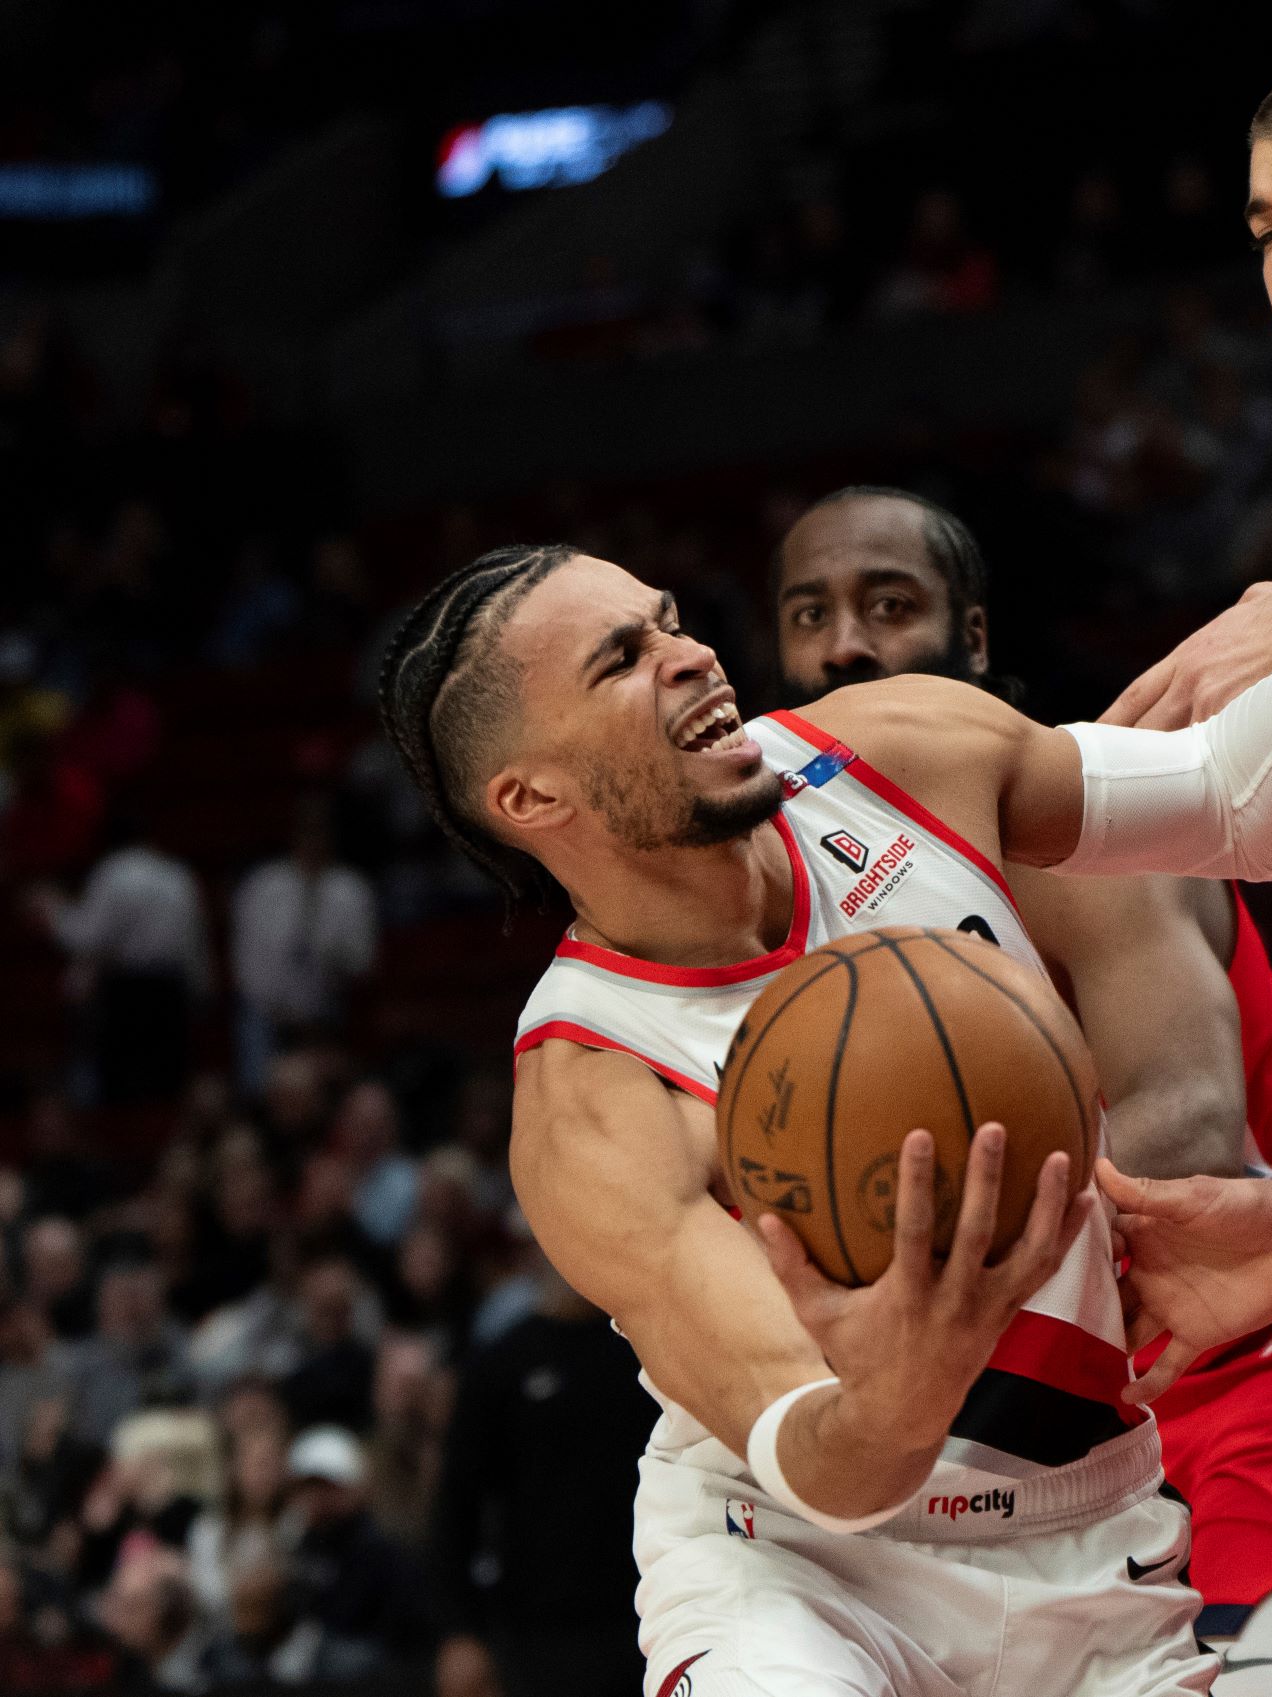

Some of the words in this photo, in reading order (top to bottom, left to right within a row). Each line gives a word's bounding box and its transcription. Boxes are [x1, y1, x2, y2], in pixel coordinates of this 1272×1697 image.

[839, 833, 915, 918] BRIGHTSIDE
[867, 861, 914, 911] WINDOWS
[928, 1487, 1015, 1522] ripcity
